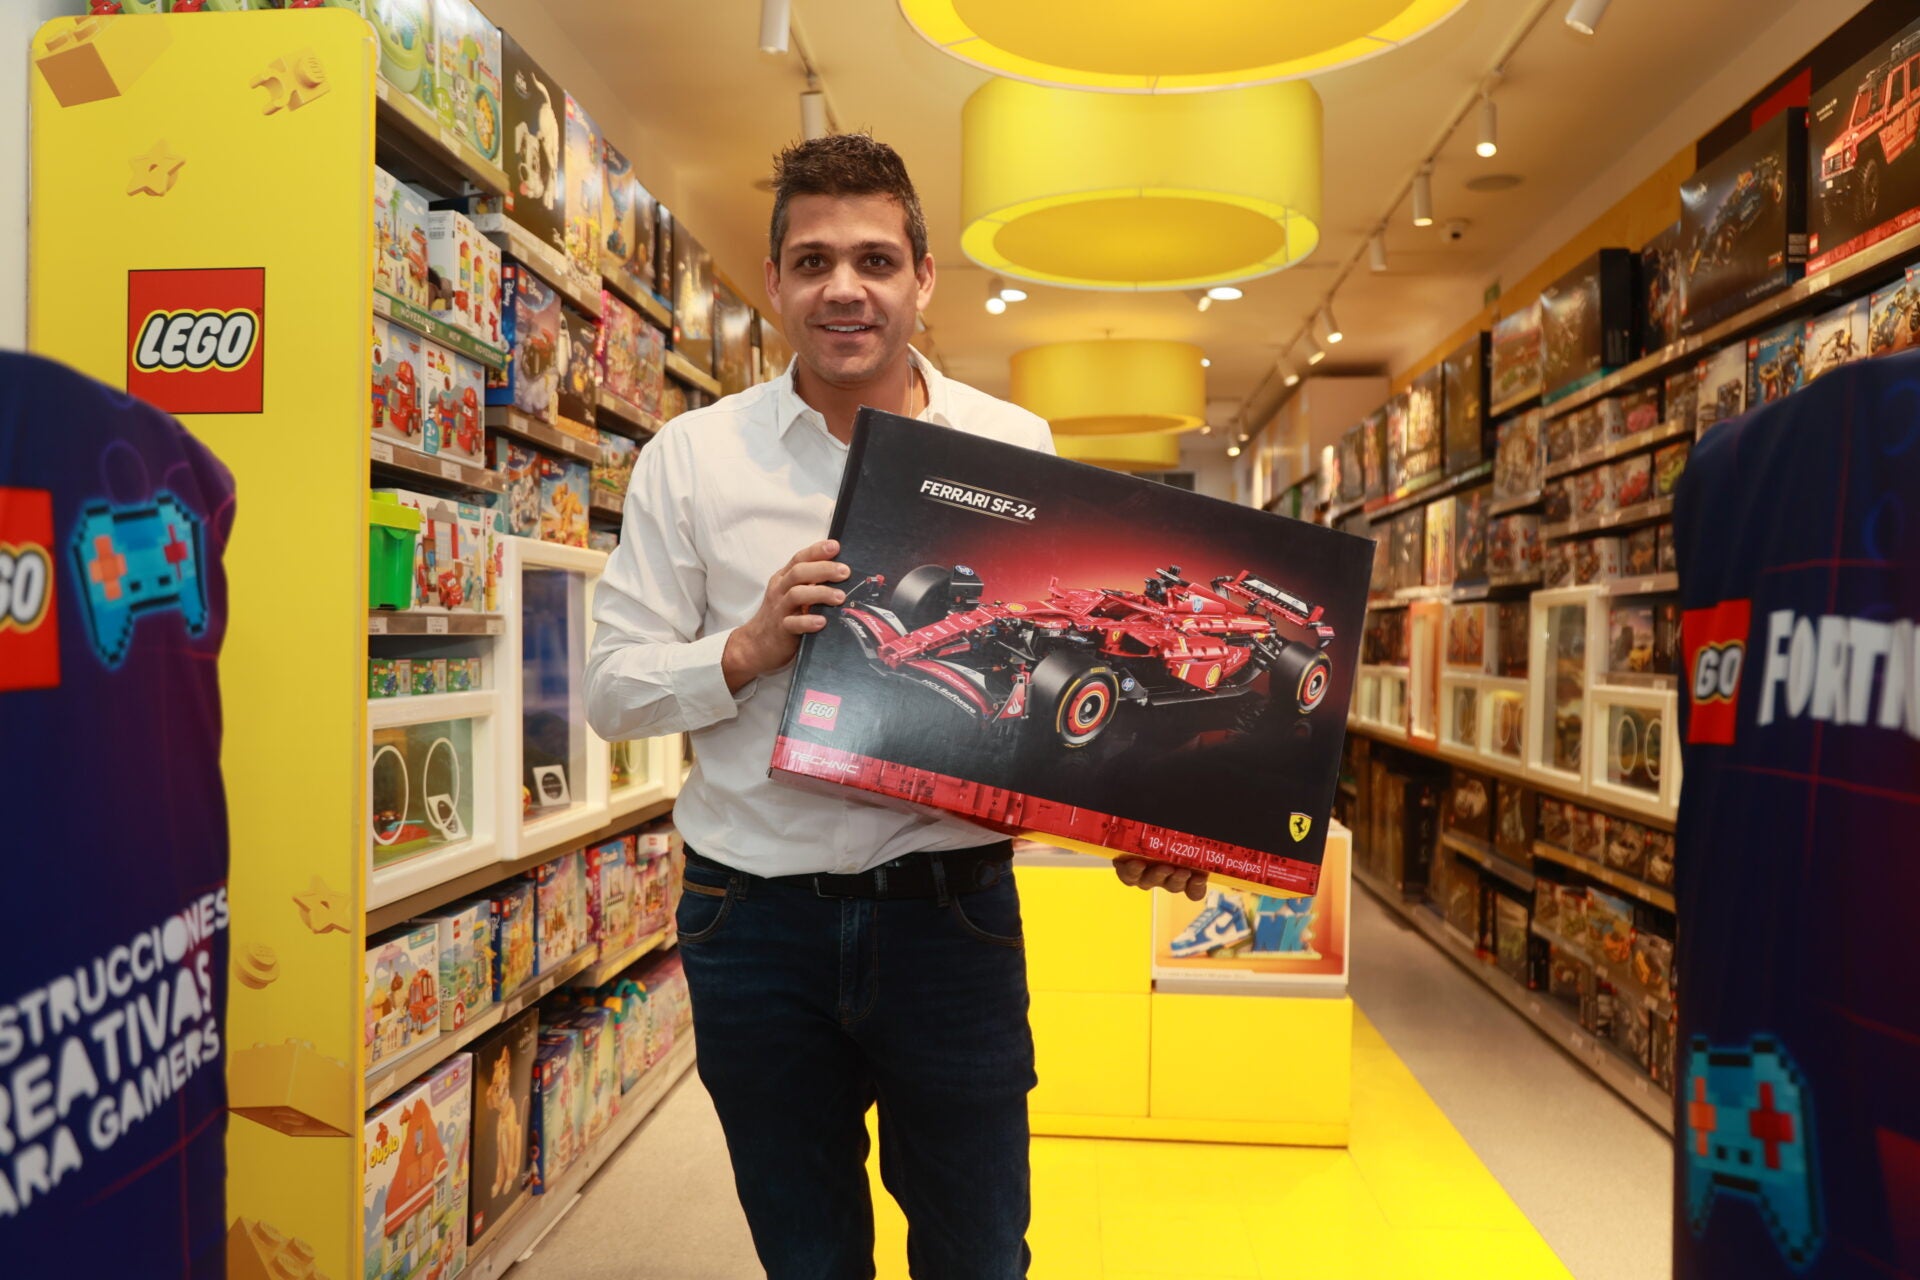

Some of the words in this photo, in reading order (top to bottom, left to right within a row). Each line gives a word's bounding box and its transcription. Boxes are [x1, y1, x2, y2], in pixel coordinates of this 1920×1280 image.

[137, 313, 255, 368] LEGO
[920, 480, 990, 508] FERRARI
[990, 498, 1036, 520] SF-24
[804, 702, 835, 718] LEGO
[790, 750, 859, 774] TECHNIC
[1149, 837, 1164, 849] 18+
[1170, 842, 1200, 858] 42207
[1205, 850, 1225, 864] 1361
[1225, 857, 1261, 874] pcs/pzs
[90, 1018, 220, 1150] GAMERS
[369, 1136, 399, 1168] duplo
